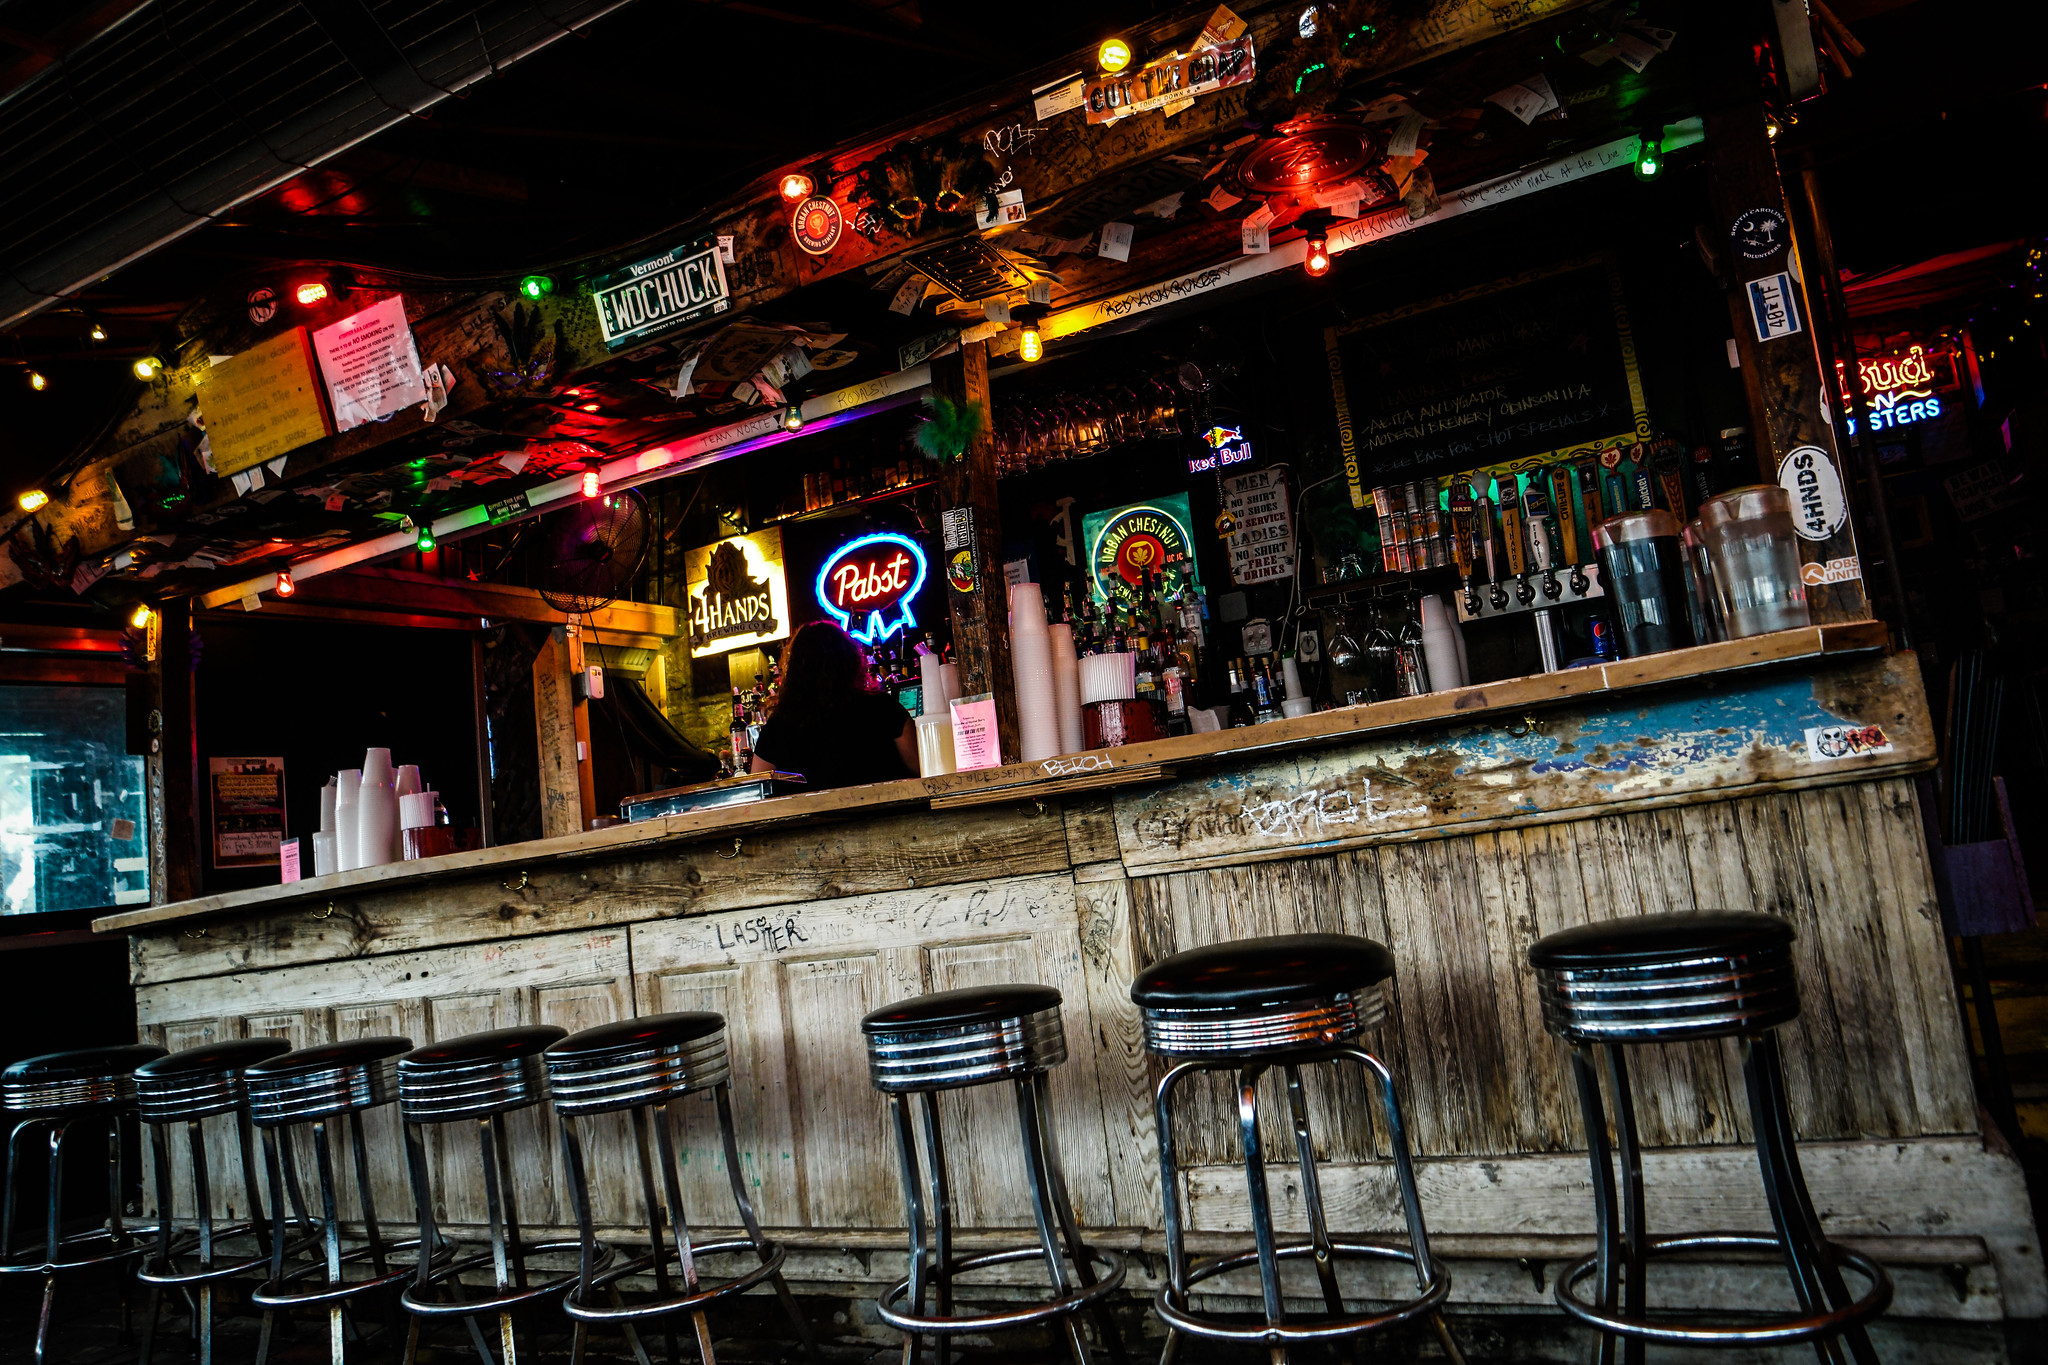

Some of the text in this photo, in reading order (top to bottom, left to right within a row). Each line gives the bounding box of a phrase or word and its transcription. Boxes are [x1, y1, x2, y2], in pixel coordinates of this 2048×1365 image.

[1090, 79, 1132, 113] CUT
[1188, 47, 1246, 83] CRAP
[797, 200, 835, 230] URBAN CHESTNUT
[1730, 208, 1786, 237] SOUTH CAROLINA
[1743, 243, 1782, 259] VOLUNTEERS
[629, 251, 675, 277] Vermont
[610, 256, 719, 331] WDCHUCK
[601, 297, 616, 333] TRK
[636, 322, 669, 338] INDEPENDENT
[669, 319, 677, 327] TO
[676, 315, 687, 325] THE
[352, 337, 360, 346] NO
[360, 328, 382, 342] SMOKING
[1428, 408, 1492, 434] BREWERY
[700, 432, 732, 448] TEAM
[1415, 448, 1444, 464] BAR
[1448, 442, 1473, 456] FOR
[1476, 427, 1513, 449] SHOT
[1520, 409, 1593, 438] SPECIALS
[1219, 442, 1252, 466] Bull
[1235, 472, 1270, 492] MEN
[1793, 453, 1827, 533] 4HNDS
[1230, 490, 1277, 508] NO SHIRT
[1248, 502, 1278, 517] SHOES
[1452, 504, 1473, 513] HAZE
[1246, 511, 1286, 528] SERVICE
[1101, 517, 1180, 563] URBAN CHESTNUT
[1230, 524, 1290, 548] LADIES
[1236, 542, 1288, 562] NO SHIRT
[1248, 555, 1278, 570] FREE
[1243, 564, 1286, 581] DRINKS
[1825, 557, 1858, 572] JOBS
[833, 552, 910, 607] Pabst
[705, 624, 746, 640] BREWING
